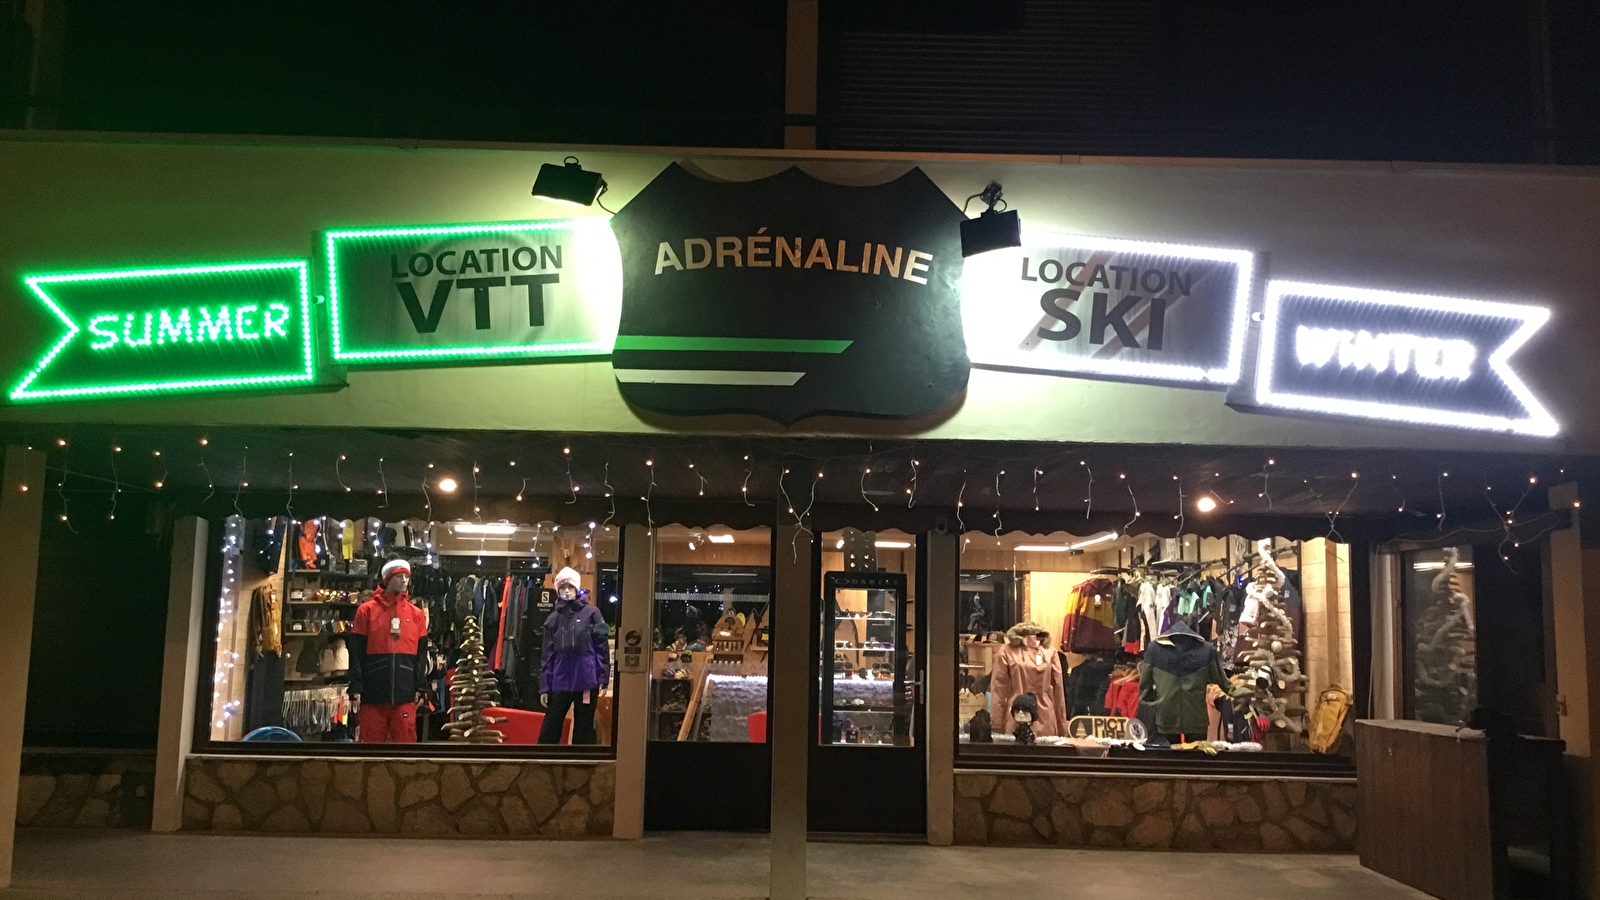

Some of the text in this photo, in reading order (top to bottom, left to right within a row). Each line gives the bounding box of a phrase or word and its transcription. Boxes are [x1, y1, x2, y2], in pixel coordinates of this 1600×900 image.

[391, 245, 562, 278] LOCATION
[654, 227, 934, 285] ADRÉNALINE
[1021, 257, 1192, 296] LOCATION
[88, 302, 290, 350] SUMMER
[396, 273, 560, 333] VTT
[1037, 288, 1166, 350] SKI
